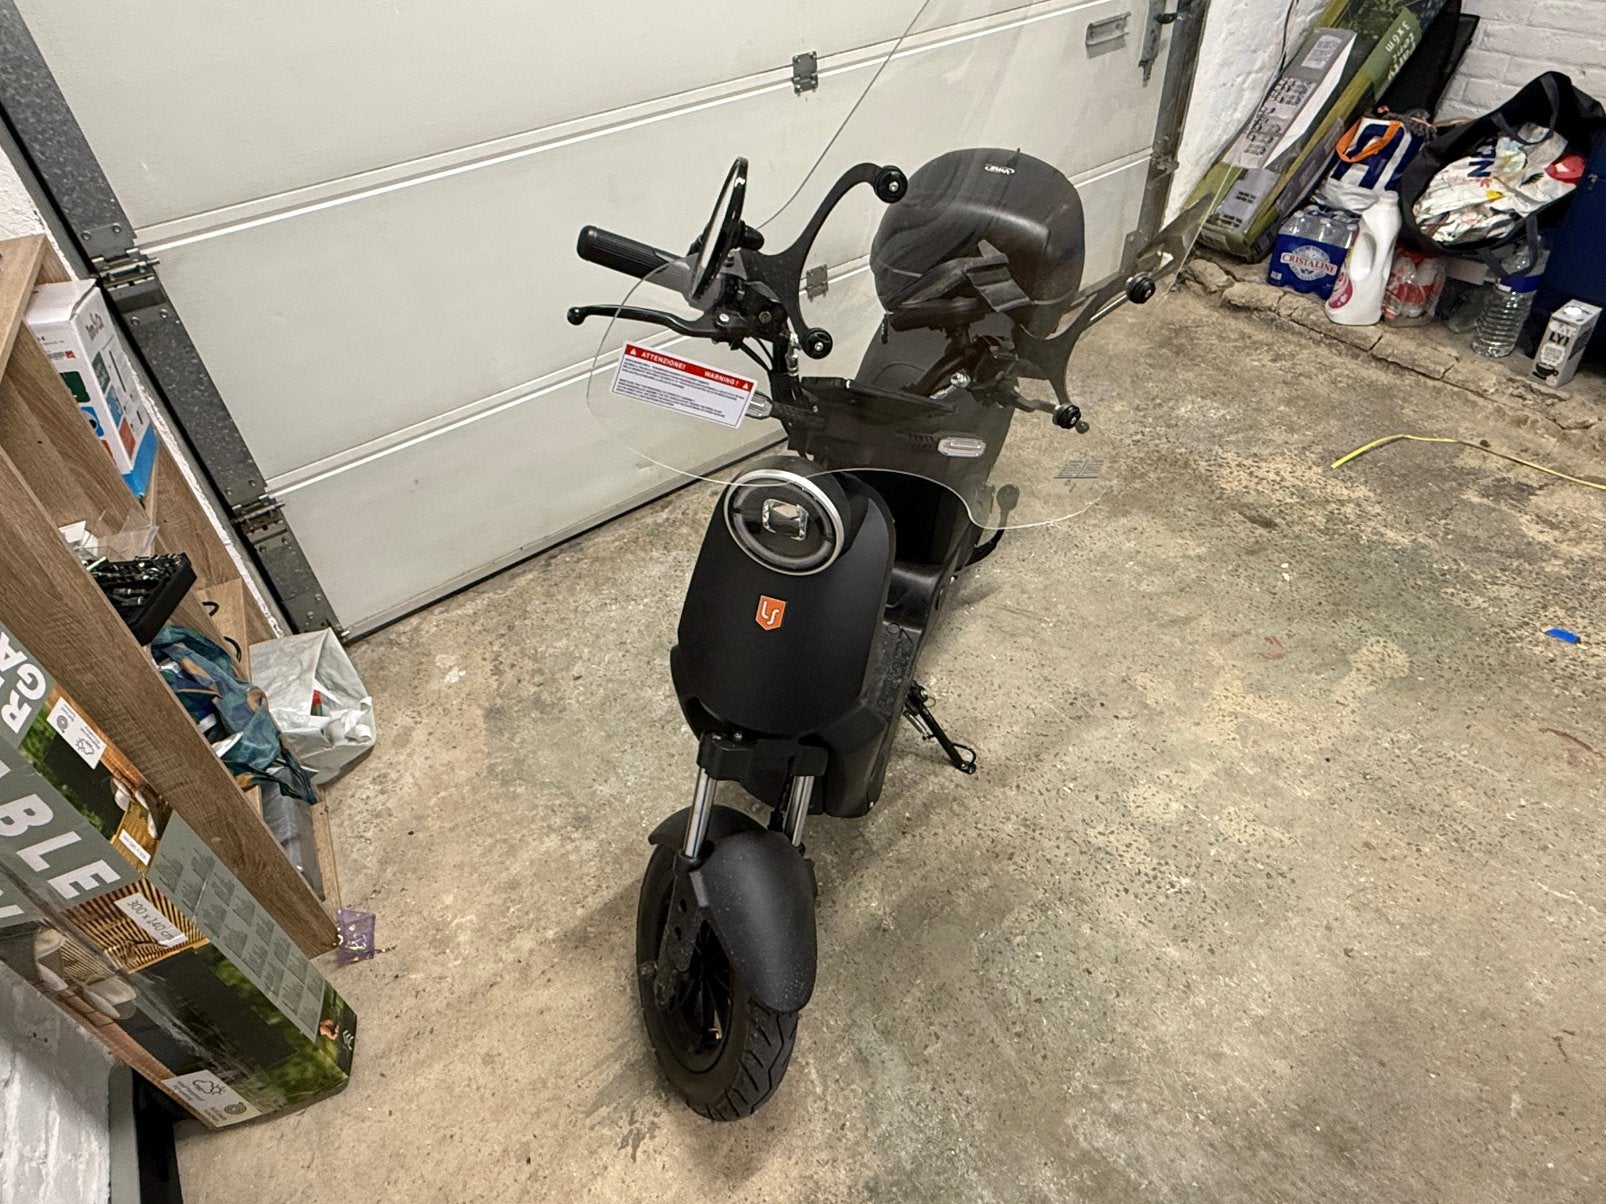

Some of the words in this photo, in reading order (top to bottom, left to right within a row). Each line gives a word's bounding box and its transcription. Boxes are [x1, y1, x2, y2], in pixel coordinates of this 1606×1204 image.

[1282, 253, 1336, 274] CRISTALINE
[641, 351, 686, 370] ATTENZIONE!
[0, 761, 122, 900] BLE
[127, 899, 147, 915] 300
